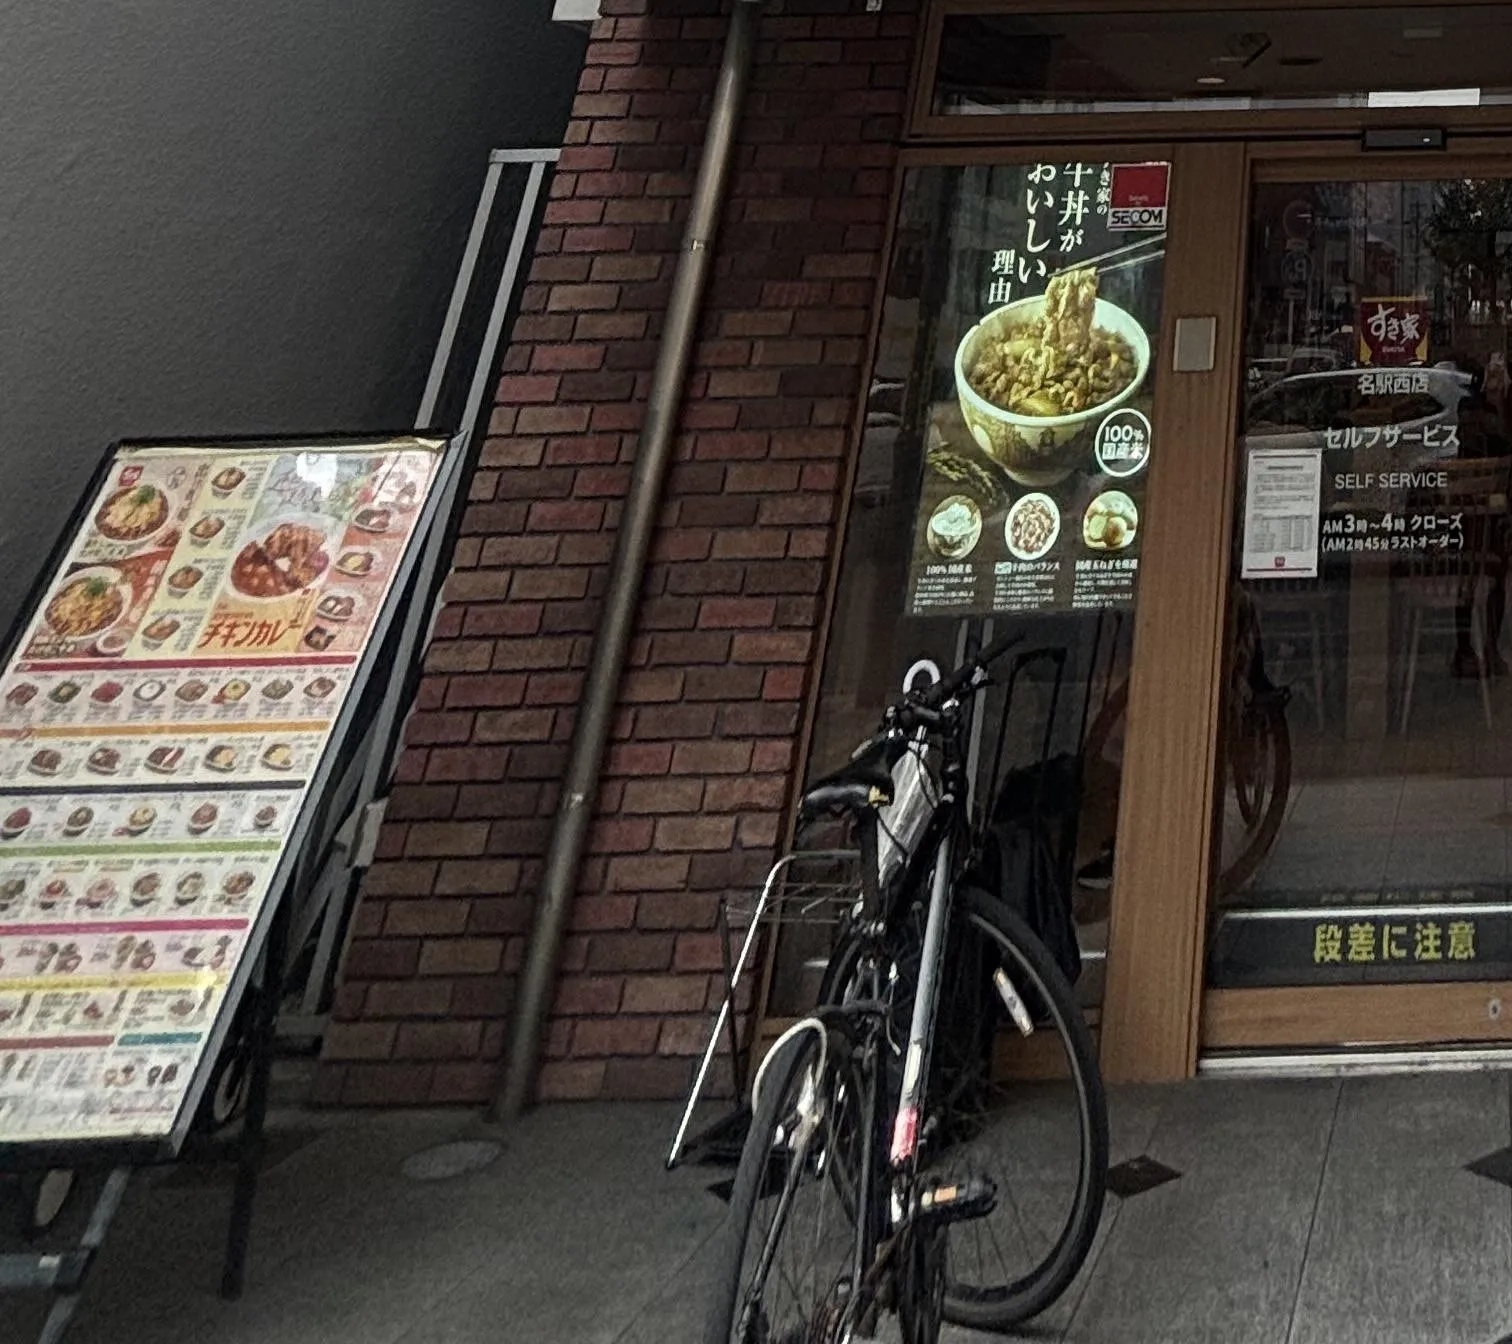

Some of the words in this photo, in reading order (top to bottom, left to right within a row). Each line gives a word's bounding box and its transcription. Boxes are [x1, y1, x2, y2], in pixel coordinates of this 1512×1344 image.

[1110, 208, 1164, 226] SECOM
[987, 248, 1016, 305] 理由
[1367, 302, 1421, 343] すき家
[1356, 372, 1430, 395] 名駅西店
[1104, 425, 1145, 443] 100%
[1323, 423, 1462, 450] セルフサービス
[1334, 474, 1374, 490] SELF
[1379, 471, 1448, 488] SERVICE
[1410, 512, 1463, 531] クローズ
[201, 616, 303, 649] チキンカレー
[1312, 920, 1477, 964] 段差に注意
